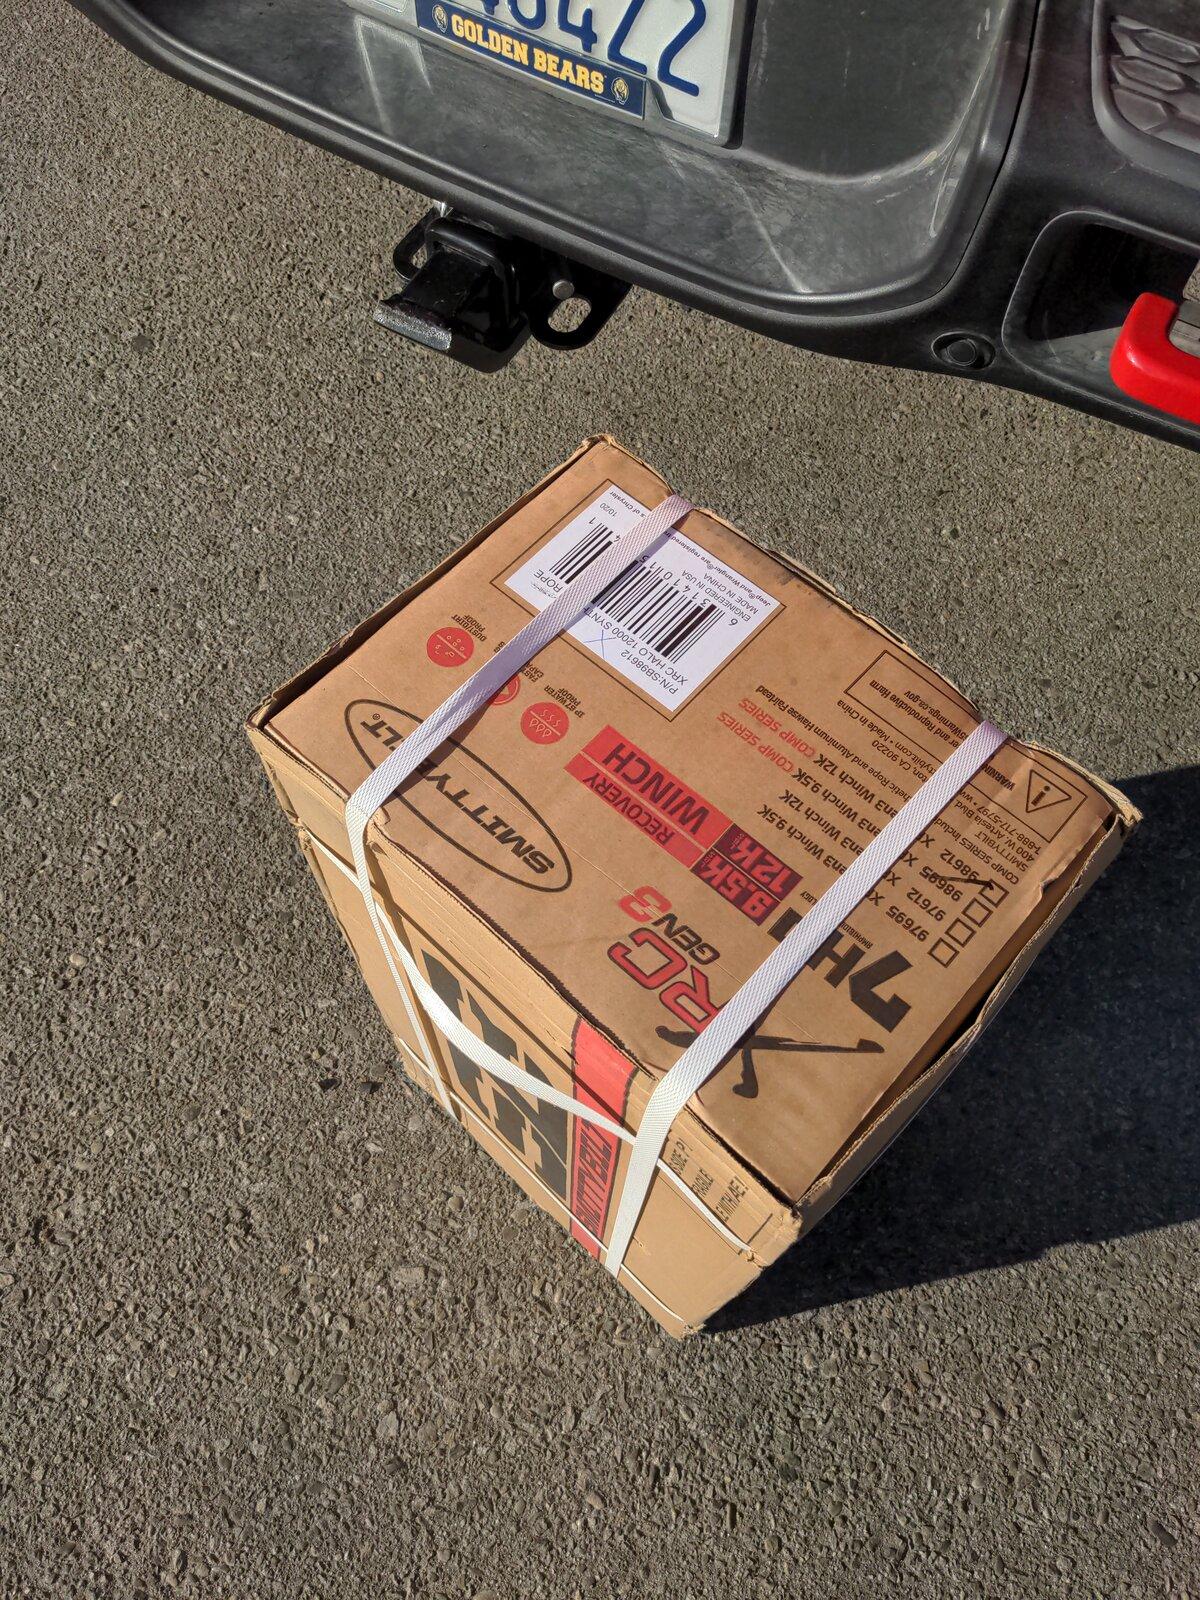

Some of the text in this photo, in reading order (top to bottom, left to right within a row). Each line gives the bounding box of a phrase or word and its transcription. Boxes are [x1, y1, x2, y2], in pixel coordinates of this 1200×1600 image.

[450, 14, 605, 95] GOLDEN BEARS
[598, 500, 618, 518] 10/20
[608, 488, 635, 511] Chrysler
[631, 506, 641, 515] of
[670, 532, 701, 559] registered
[699, 554, 711, 565] are
[532, 567, 563, 594] ROPE
[662, 567, 711, 609] 31410
[701, 571, 758, 615] MADE IN CHINA
[739, 583, 752, 595] and
[679, 568, 751, 624] ENGINEERED IN USA
[451, 611, 487, 642] DUST/DIRT
[462, 612, 486, 632] PROOF
[727, 616, 739, 628] 6
[610, 625, 638, 649] 12000
[619, 646, 679, 695] P/N:SB98612
[637, 645, 666, 669] HALO
[663, 664, 688, 686] XRC
[867, 677, 891, 699] Harm
[543, 684, 567, 705] WATER
[556, 685, 581, 707] PROOF
[754, 682, 789, 713] Fairlead
[737, 695, 782, 733] SERIES
[785, 705, 815, 731] Hawse
[835, 697, 861, 720] China
[857, 714, 869, 725] in
[887, 691, 937, 732] Reproductive
[716, 709, 761, 747] SERIES
[865, 719, 891, 742] Made
[933, 726, 950, 742] and
[778, 726, 816, 759] COMP
[811, 724, 854, 760] Aluminum
[870, 737, 899, 762] 90220
[757, 740, 795, 773] COMP
[812, 752, 839, 776] 12K
[850, 754, 867, 770] and
[897, 757, 911, 771] CA
[601, 739, 712, 834] WINCH
[791, 766, 822, 794] 9.5K
[836, 769, 876, 804] Winch
[866, 764, 891, 787] Rope
[582, 772, 675, 844] RECOVERY
[778, 787, 805, 812] 12K
[819, 787, 859, 822] Winch
[952, 798, 975, 818] Blvd.
[756, 802, 788, 831] 9.5K
[801, 805, 842, 841] Winch
[972, 813, 1003, 840] Artesia
[976, 801, 1042, 856] 1-888-717-5797
[784, 824, 825, 860] Winch
[958, 835, 992, 865] SERIES
[974, 827, 1028, 873] SMITTYBILT
[1002, 835, 1017, 849] W.
[1014, 845, 1034, 863] 400
[728, 835, 795, 895] 12K
[938, 847, 980, 882] 98612
[989, 859, 1019, 885] COMP
[698, 852, 774, 920] 9.5K
[905, 886, 946, 922] 97612
[884, 903, 930, 943] 97695
[690, 1166, 714, 1201] FRAGILE
